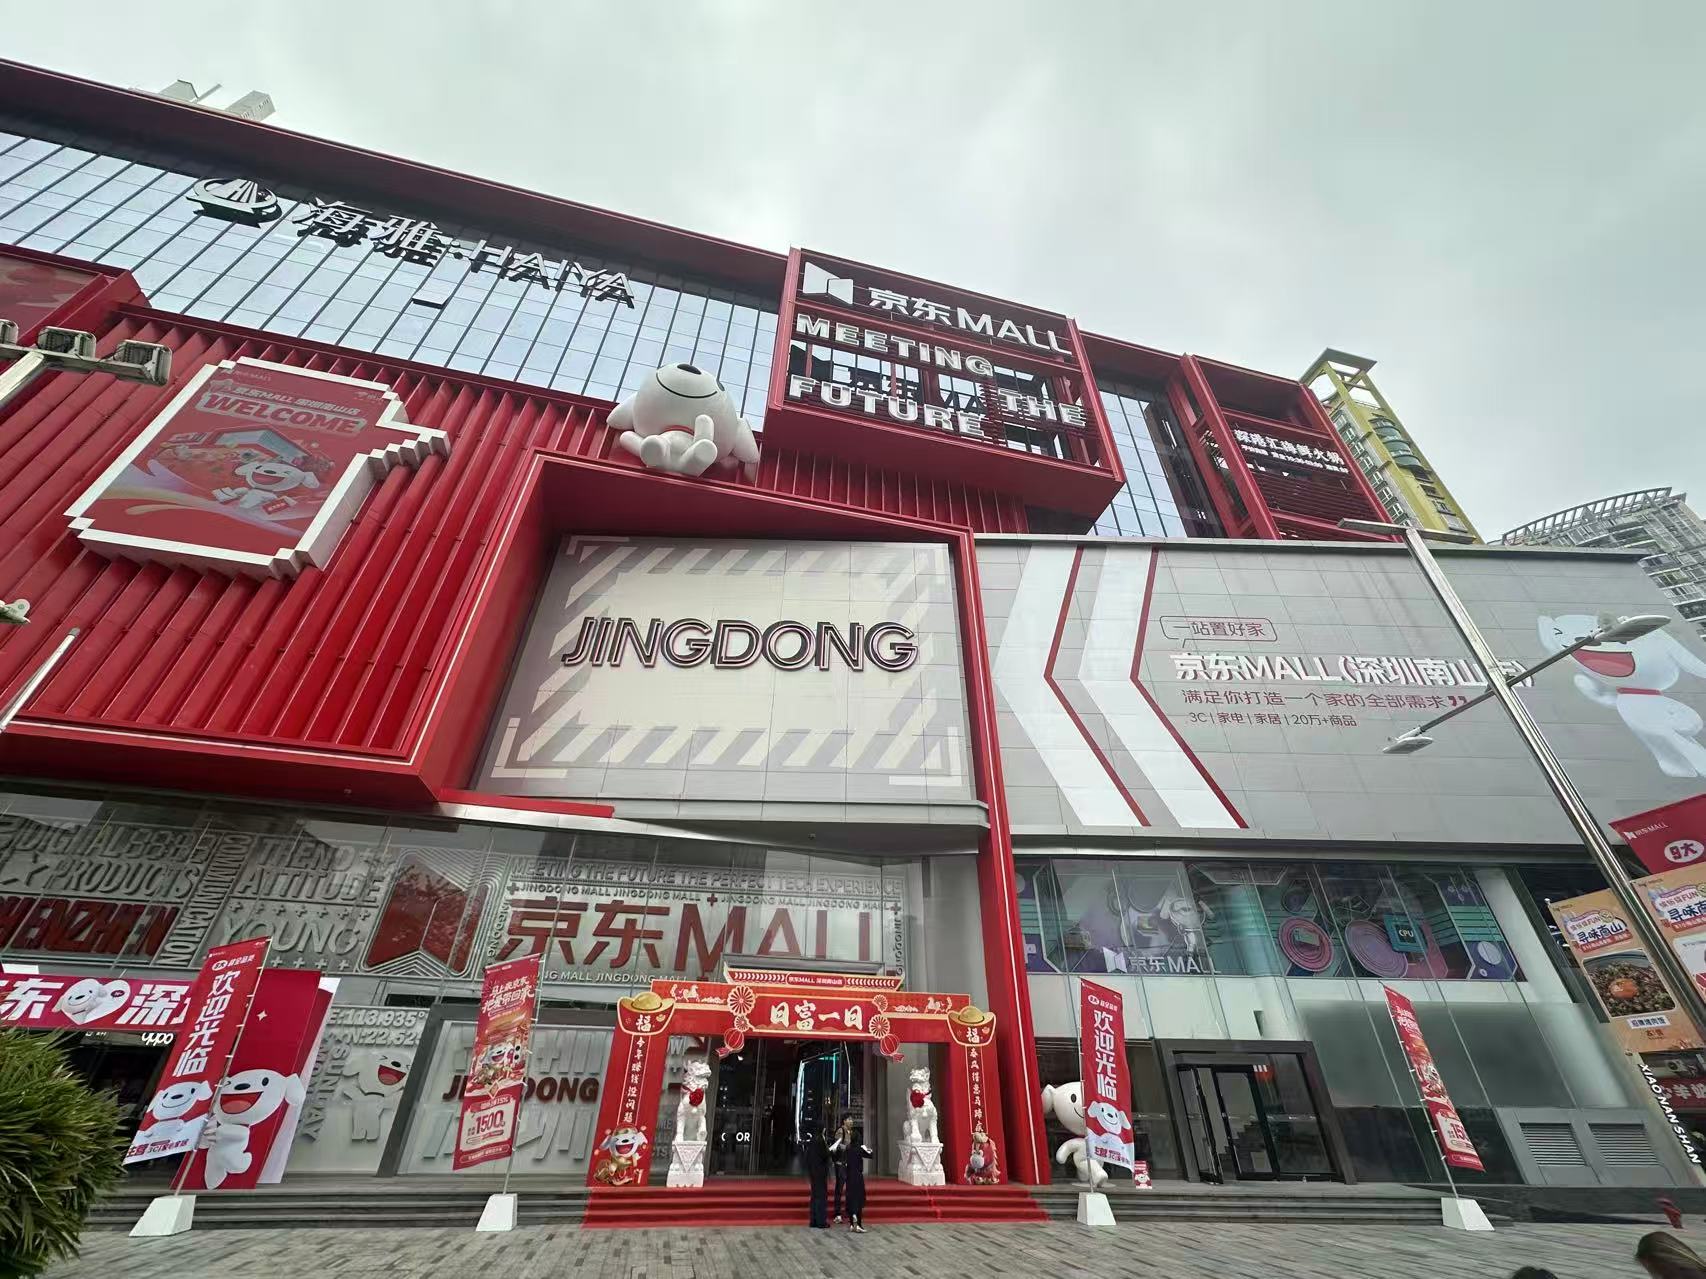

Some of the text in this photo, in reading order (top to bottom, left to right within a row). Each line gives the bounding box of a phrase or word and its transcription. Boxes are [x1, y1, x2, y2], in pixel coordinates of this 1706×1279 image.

[868, 287, 1072, 355] 京东MALL
[796, 313, 994, 377] MEETING
[204, 394, 363, 433] WELCOME
[789, 374, 986, 438] FUTURE
[999, 388, 1086, 427] THE
[562, 616, 918, 672] JINGDONG
[1173, 622, 1266, 637] 一站置好家
[43, 856, 201, 898] PRODUCTS
[237, 867, 385, 903] ATTITUDE
[511, 859, 582, 880] MEETING
[585, 863, 614, 881] THE
[617, 865, 675, 884] FUTURE
[581, 887, 611, 897] MALL
[157, 834, 251, 967] COMMUNICATION
[560, 971, 593, 981] MALL
[0, 977, 191, 1025] 东 深
[172, 970, 241, 1076] 欢迎光临
[635, 1014, 652, 1032] 福
[966, 1027, 980, 1044] 福
[1094, 1009, 1118, 1101] 欢迎光临
[1639, 1064, 1662, 1094] XIAO
[1657, 1096, 1679, 1123] NAN
[1673, 1125, 1702, 1165] SHAN
